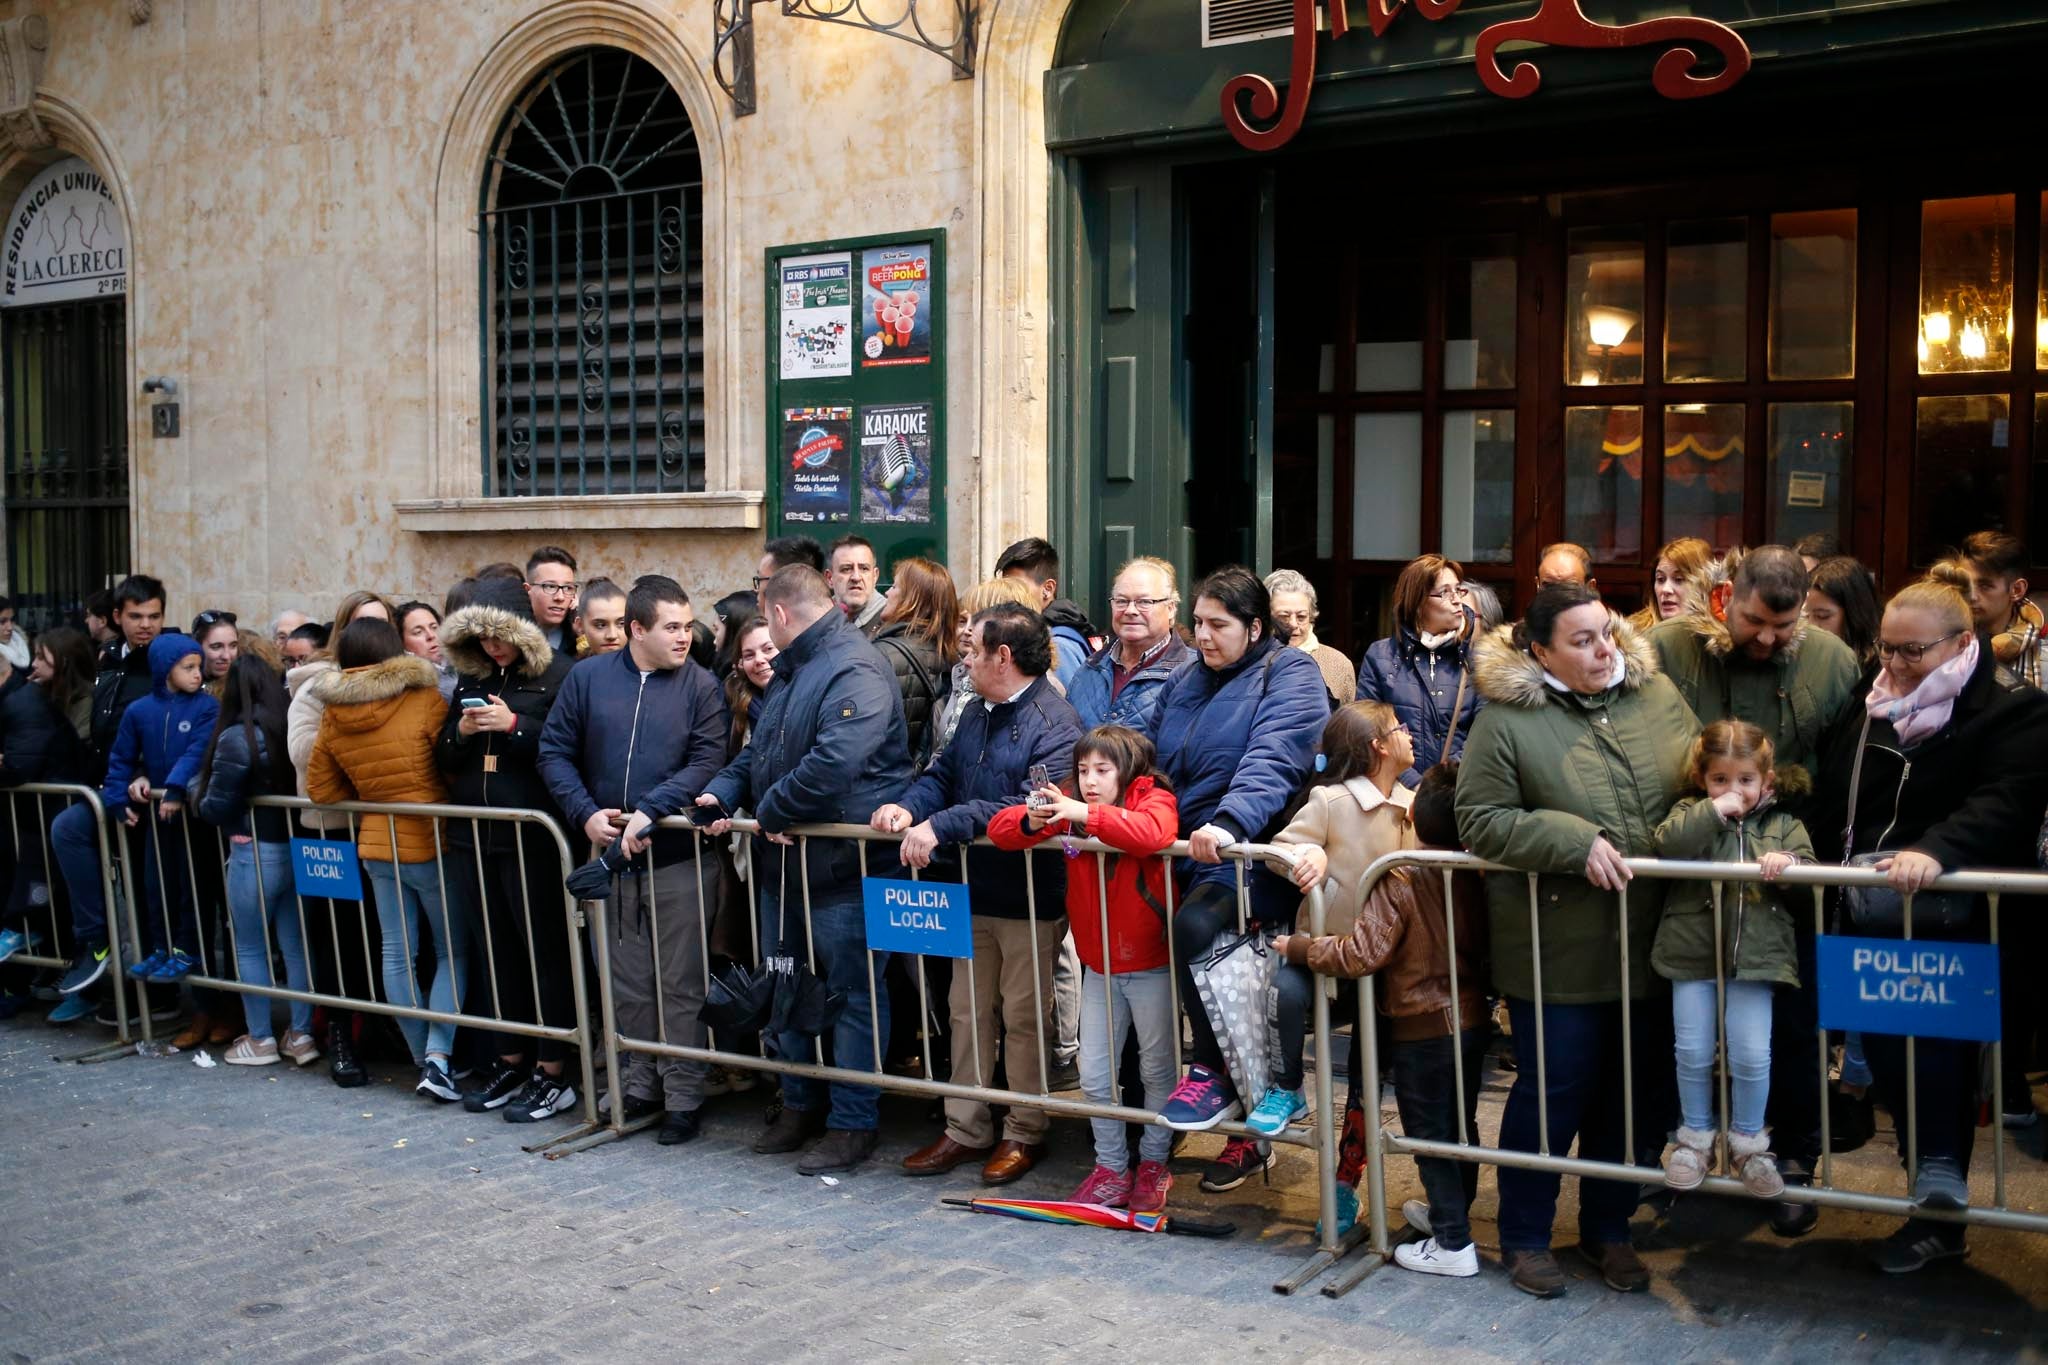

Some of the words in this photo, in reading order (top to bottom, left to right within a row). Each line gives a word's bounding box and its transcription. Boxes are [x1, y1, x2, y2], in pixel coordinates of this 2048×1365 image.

[6, 179, 60, 296] RESIDENCIA
[22, 261, 44, 281] LA
[794, 270, 809, 280] RBS
[819, 266, 844, 278] NATIONS
[865, 412, 927, 436] KARAOKE
[302, 845, 344, 862] POLICIA
[306, 863, 344, 880] LOCAL
[885, 888, 949, 909] POLICIA
[889, 910, 947, 931] LOCAL
[1853, 948, 1965, 976] POLICIA
[1860, 977, 1957, 1004] LOCAL
